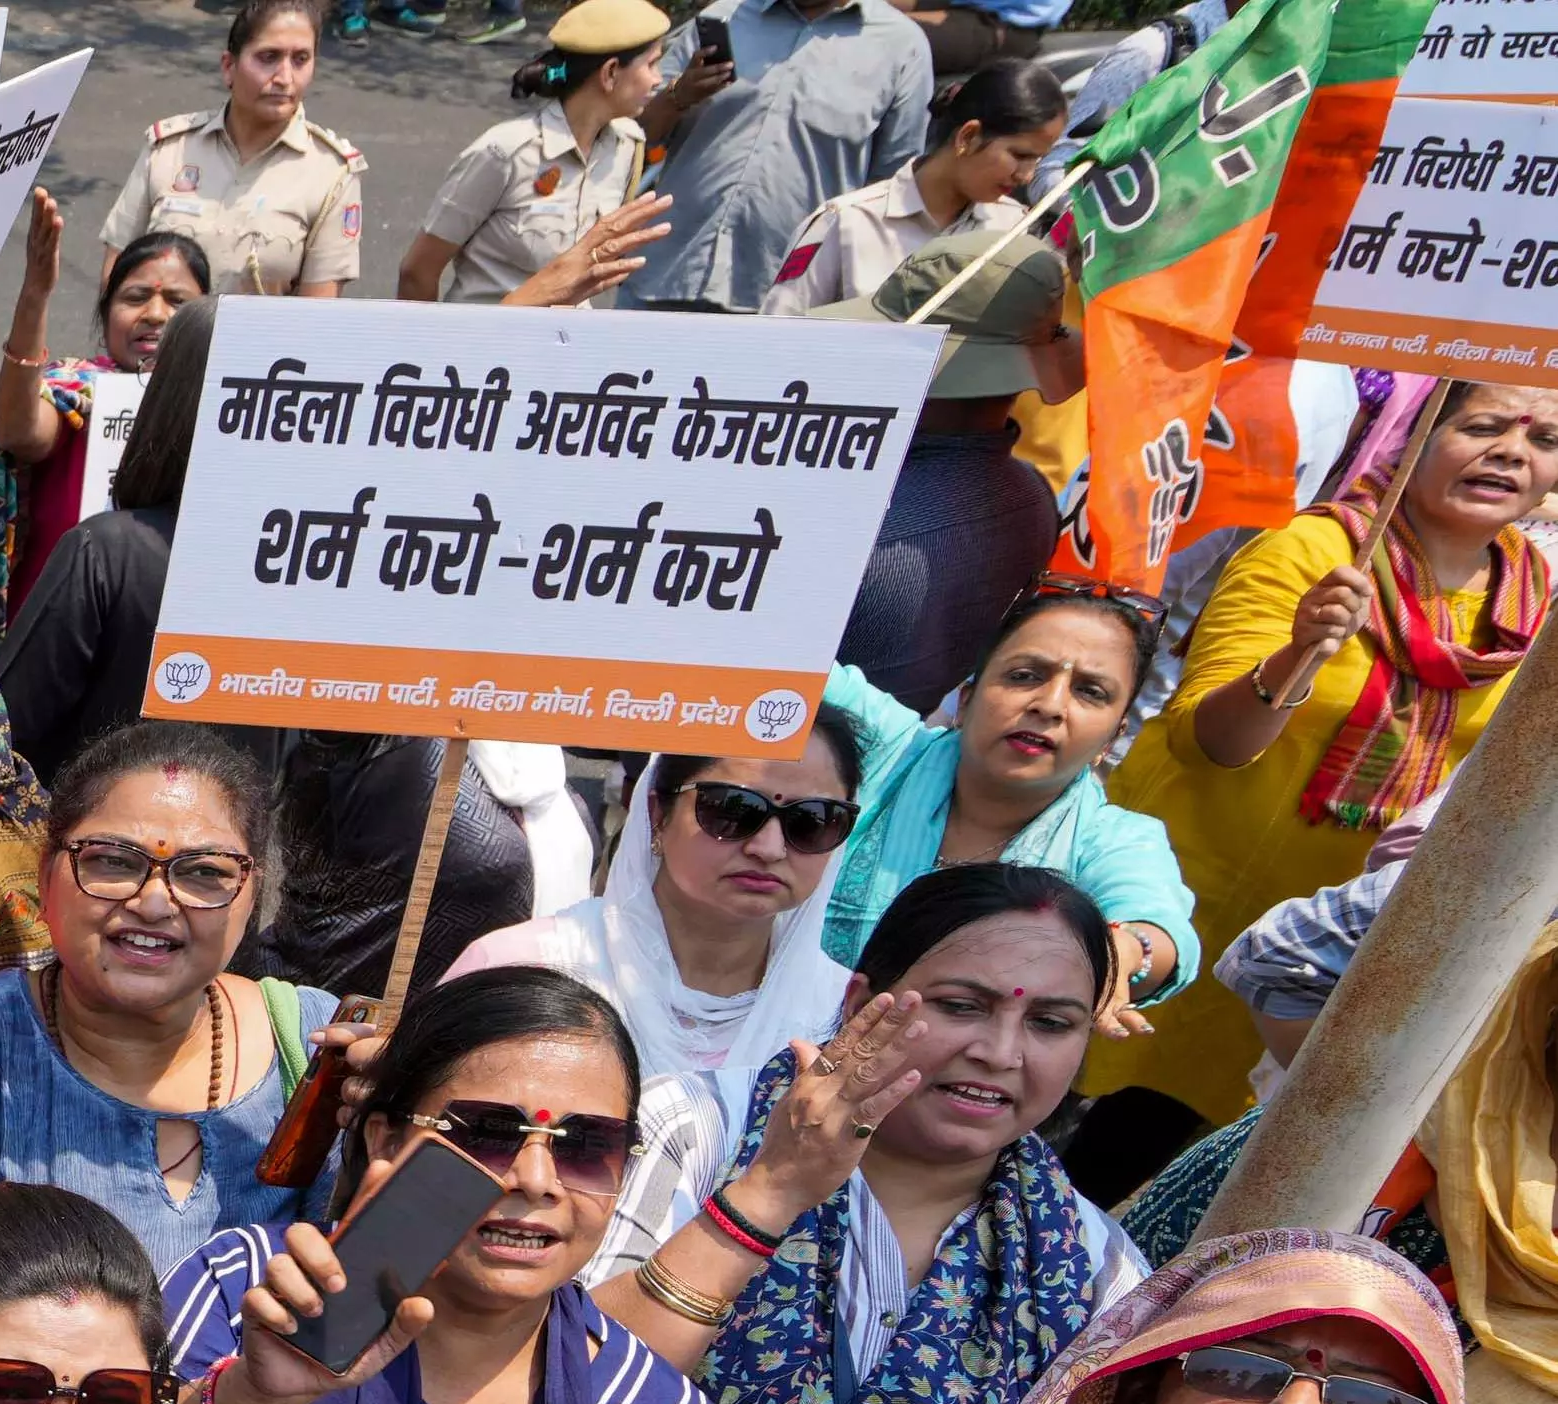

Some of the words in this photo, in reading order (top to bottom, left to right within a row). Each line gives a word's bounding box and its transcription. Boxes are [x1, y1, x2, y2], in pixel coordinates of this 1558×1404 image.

[1403, 137, 1504, 192] विरोधी
[218, 358, 364, 444] महिला
[368, 363, 512, 451] विरोधी
[515, 369, 668, 459] अरविंद
[672, 377, 898, 470] केजरीवाल
[254, 487, 377, 588] शर्म
[652, 508, 782, 611] करो
[219, 667, 306, 697] भारतीय
[310, 679, 382, 702] जनता
[449, 680, 529, 711] महिला
[603, 688, 677, 721] दिल्ली
[678, 696, 741, 725] प्रदेश
